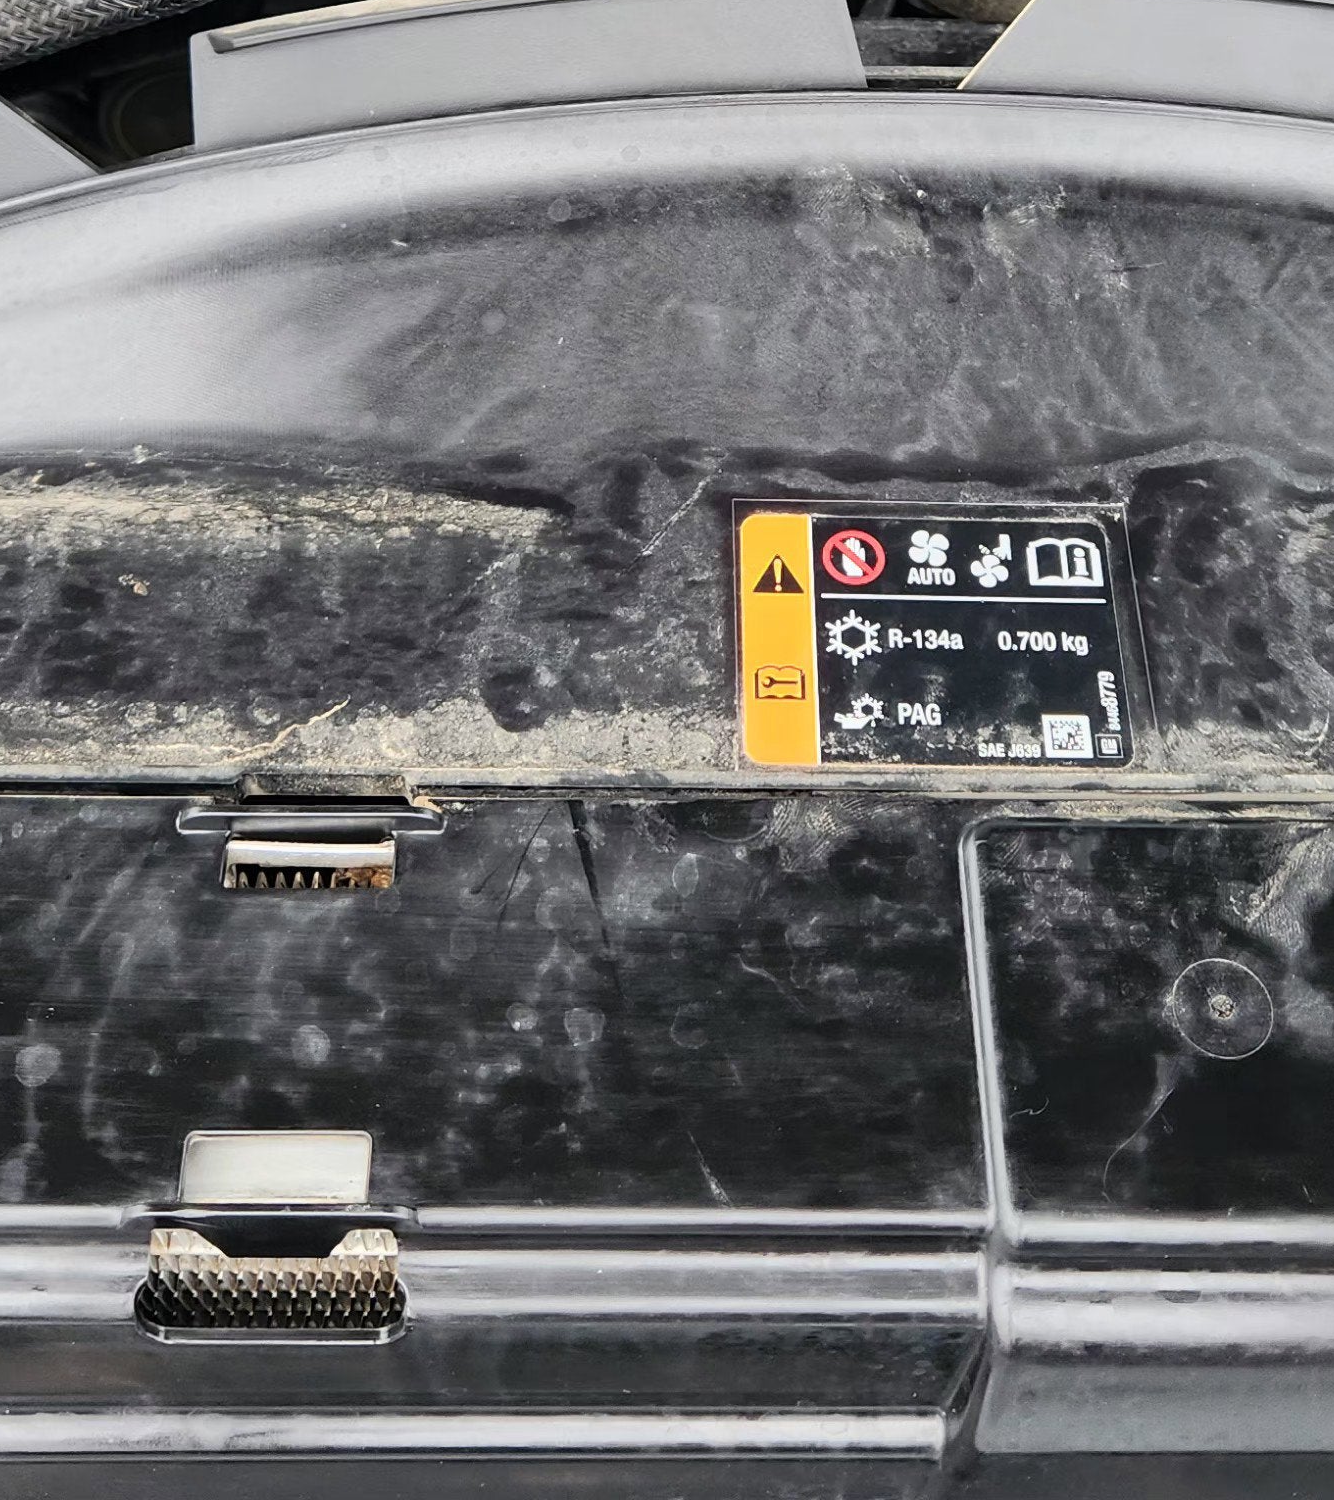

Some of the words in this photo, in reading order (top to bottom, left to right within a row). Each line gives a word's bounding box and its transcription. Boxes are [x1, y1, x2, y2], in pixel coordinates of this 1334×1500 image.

[907, 567, 956, 586] AUTO
[887, 629, 965, 651] R-134a
[997, 631, 1057, 652] 0.700
[1061, 631, 1090, 657] kg
[897, 702, 942, 726] PAG
[978, 742, 1006, 758] SAE
[1007, 743, 1042, 759] J639
